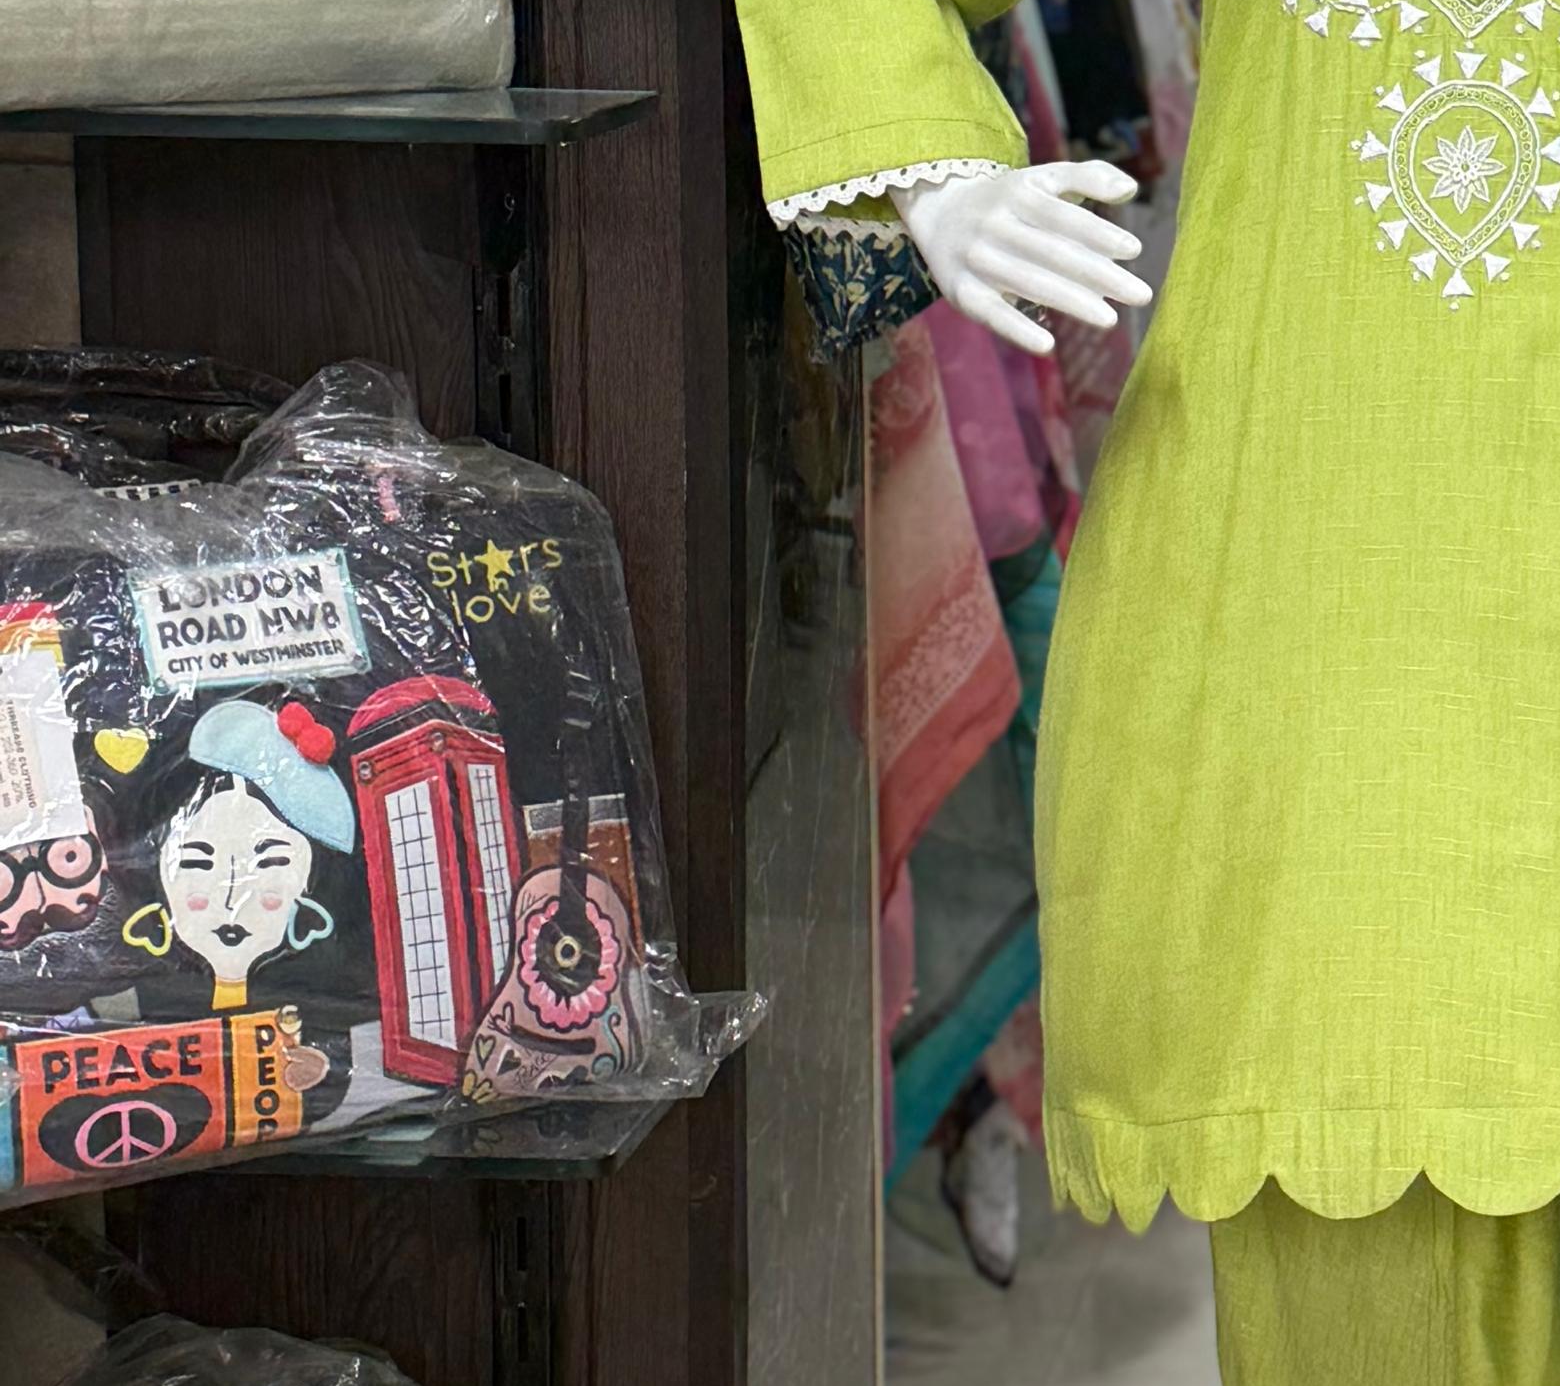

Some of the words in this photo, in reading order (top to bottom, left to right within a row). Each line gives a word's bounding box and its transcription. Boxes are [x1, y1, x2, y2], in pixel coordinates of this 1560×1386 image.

[158, 565, 323, 613] LONDON
[451, 584, 551, 626] love
[157, 613, 247, 650] ROAD
[258, 601, 341, 637] NW8
[168, 655, 204, 674] CITY
[209, 651, 229, 669] OF
[233, 639, 346, 666] WESTMINSTER
[41, 1034, 203, 1093] PEACE
